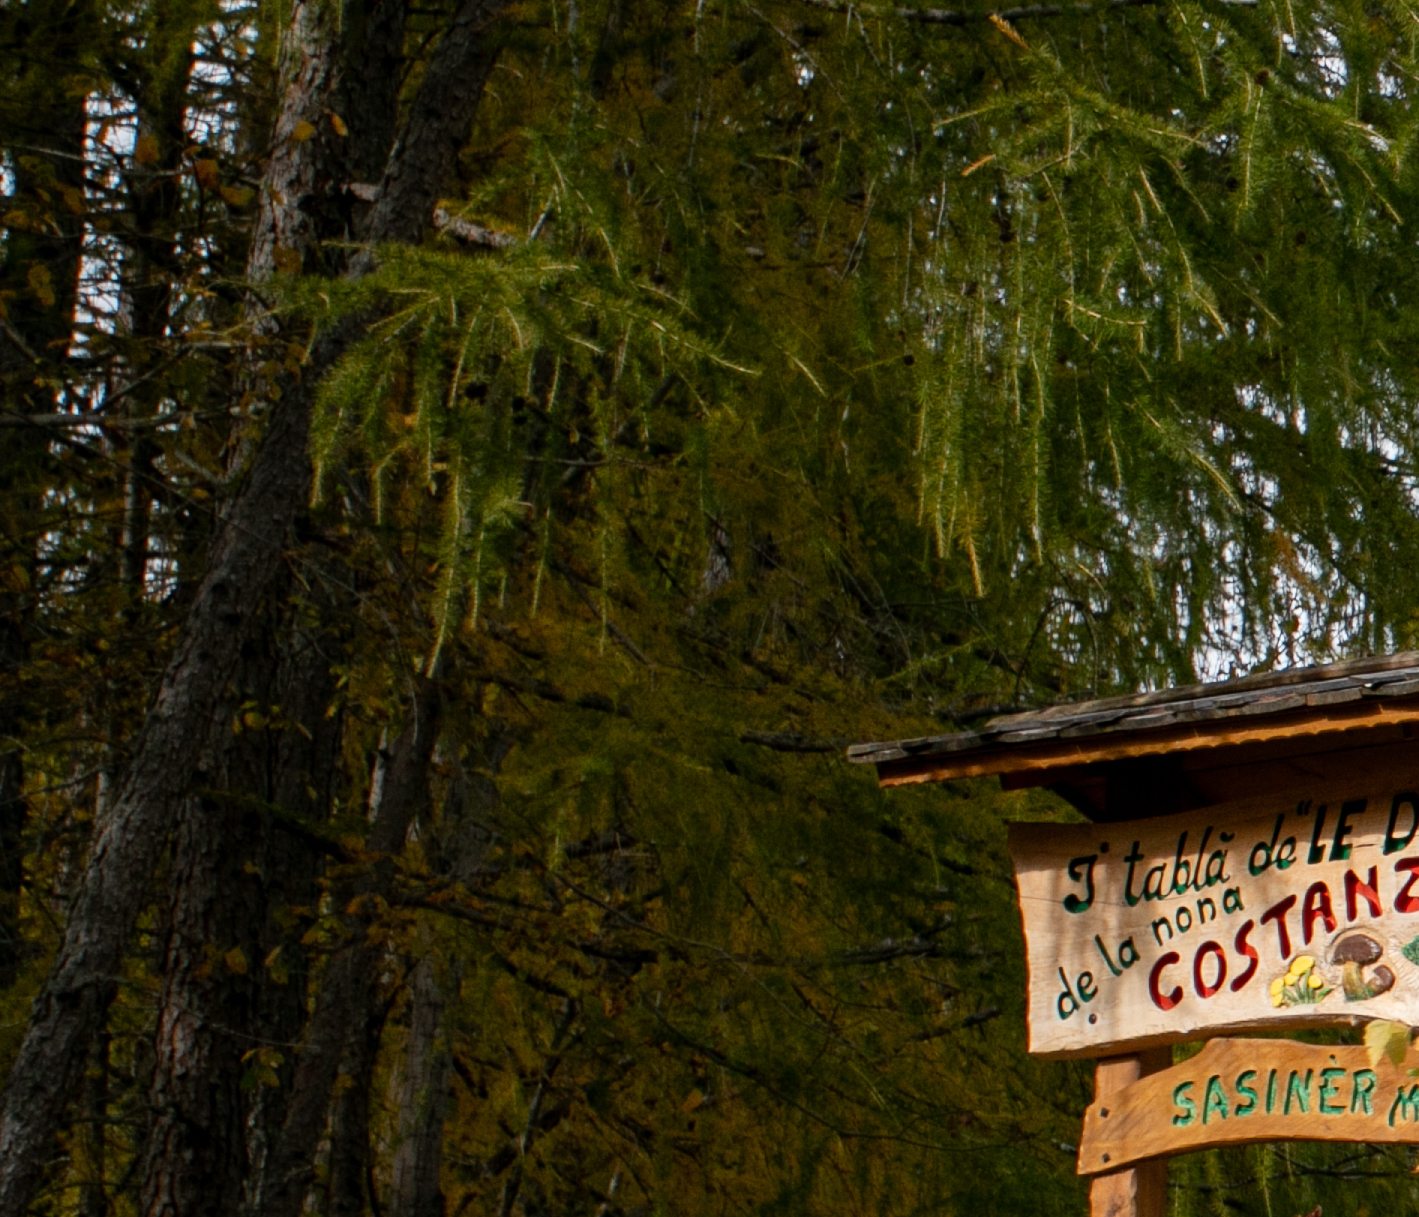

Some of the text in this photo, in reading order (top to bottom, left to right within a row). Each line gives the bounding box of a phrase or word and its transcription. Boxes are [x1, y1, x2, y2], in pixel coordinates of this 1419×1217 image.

[1247, 812, 1298, 878] de
[1056, 885, 1246, 1021] de la nona
